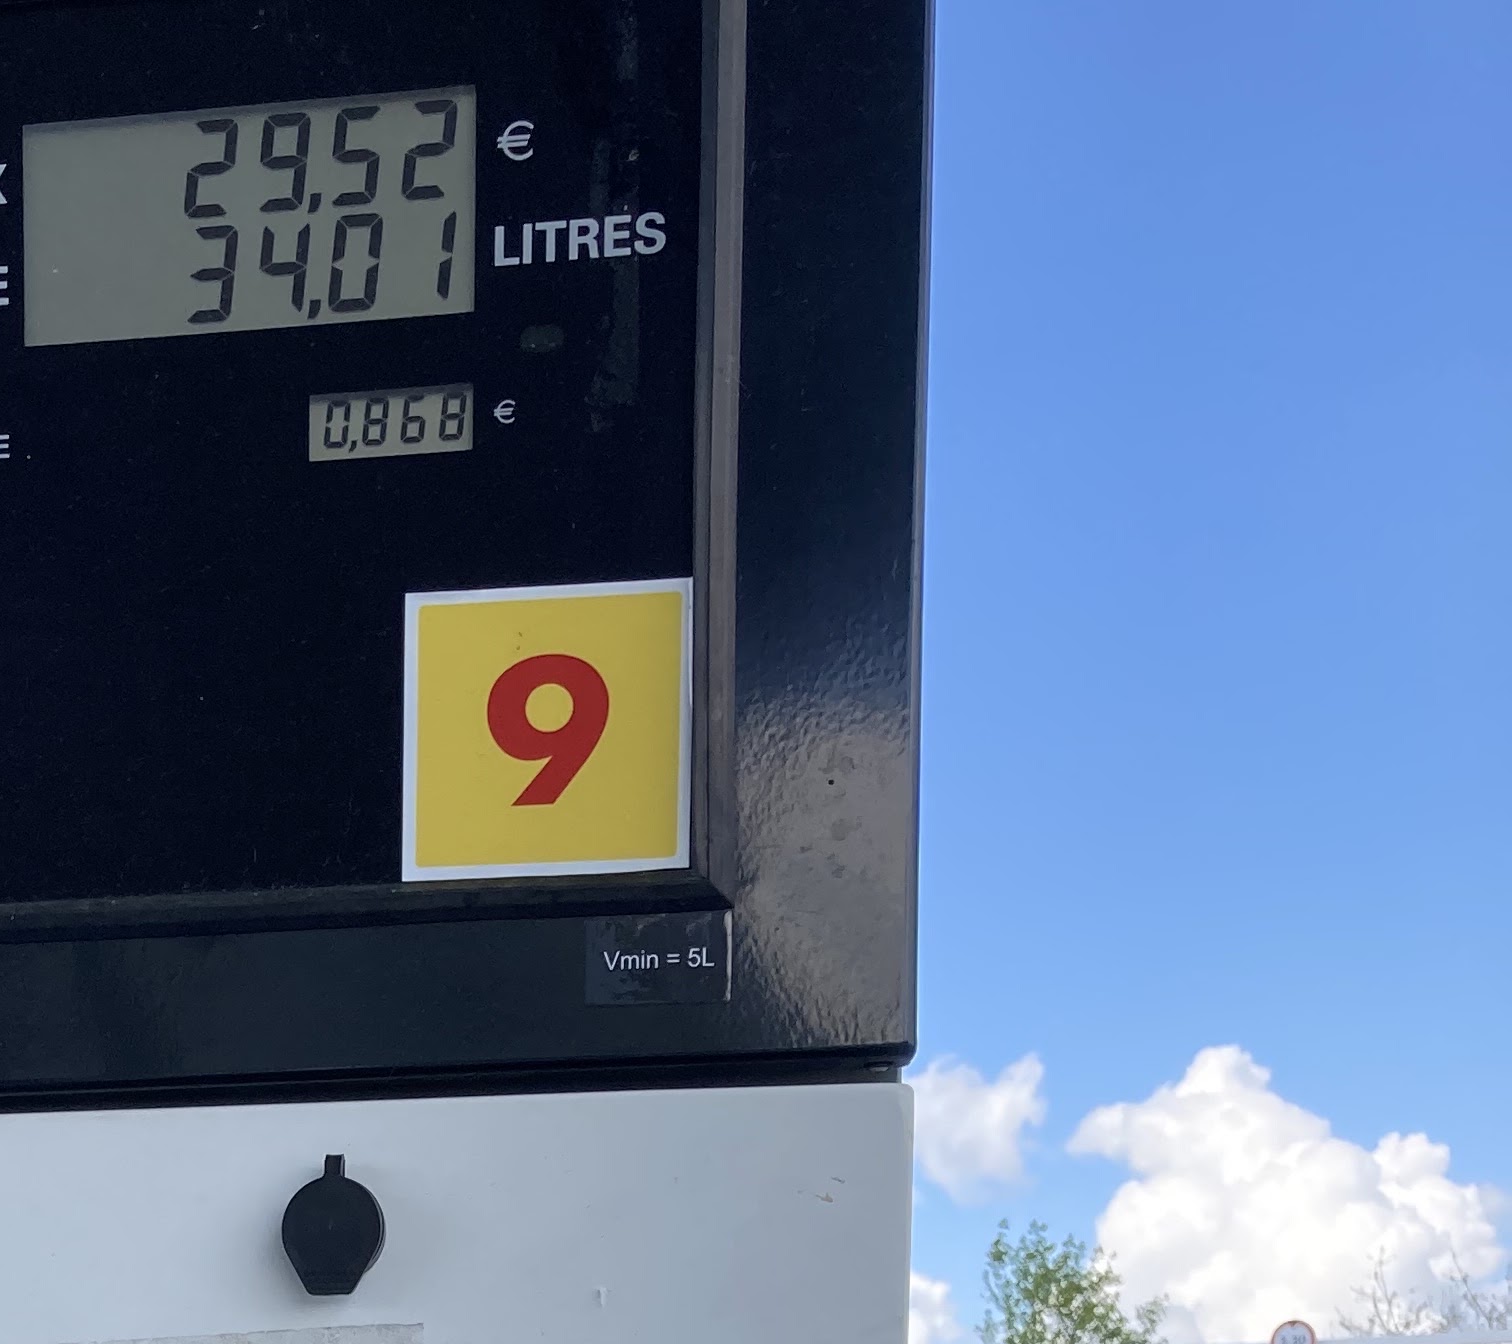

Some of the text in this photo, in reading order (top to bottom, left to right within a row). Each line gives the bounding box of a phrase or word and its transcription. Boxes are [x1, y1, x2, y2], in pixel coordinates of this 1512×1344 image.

[185, 99, 456, 219] 29,52
[496, 120, 535, 162] €
[189, 213, 456, 324] 34,01
[494, 213, 666, 268] LITRES
[324, 392, 465, 452] 0,868
[494, 399, 516, 425] €
[487, 654, 610, 807] 9
[604, 947, 715, 970] Vmin = 5L
